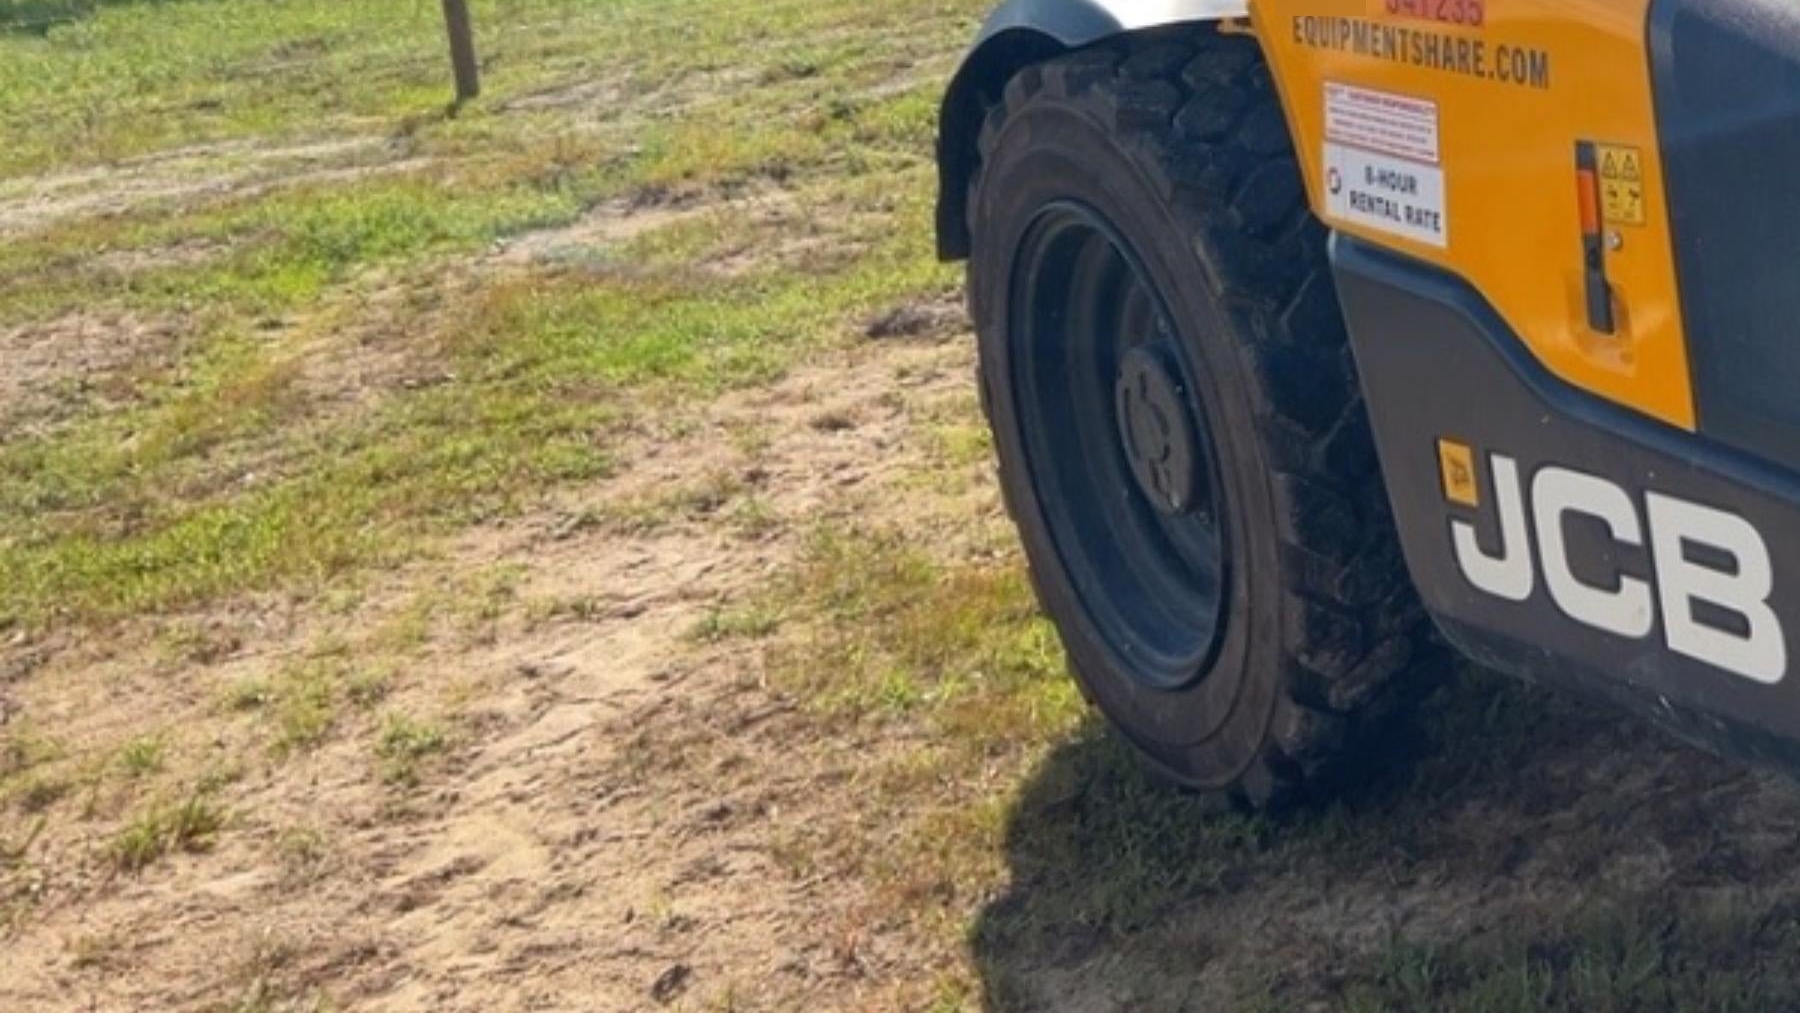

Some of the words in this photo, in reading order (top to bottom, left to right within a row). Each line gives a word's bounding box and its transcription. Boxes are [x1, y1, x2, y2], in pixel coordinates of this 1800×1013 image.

[1292, 14, 1550, 89] EQUIPMENTSHARE.COM
[1364, 165, 1418, 196] 8-HOUR
[1349, 190, 1401, 223] RENTAL
[1404, 204, 1441, 234] RATE
[1450, 452, 1786, 685] JCB
